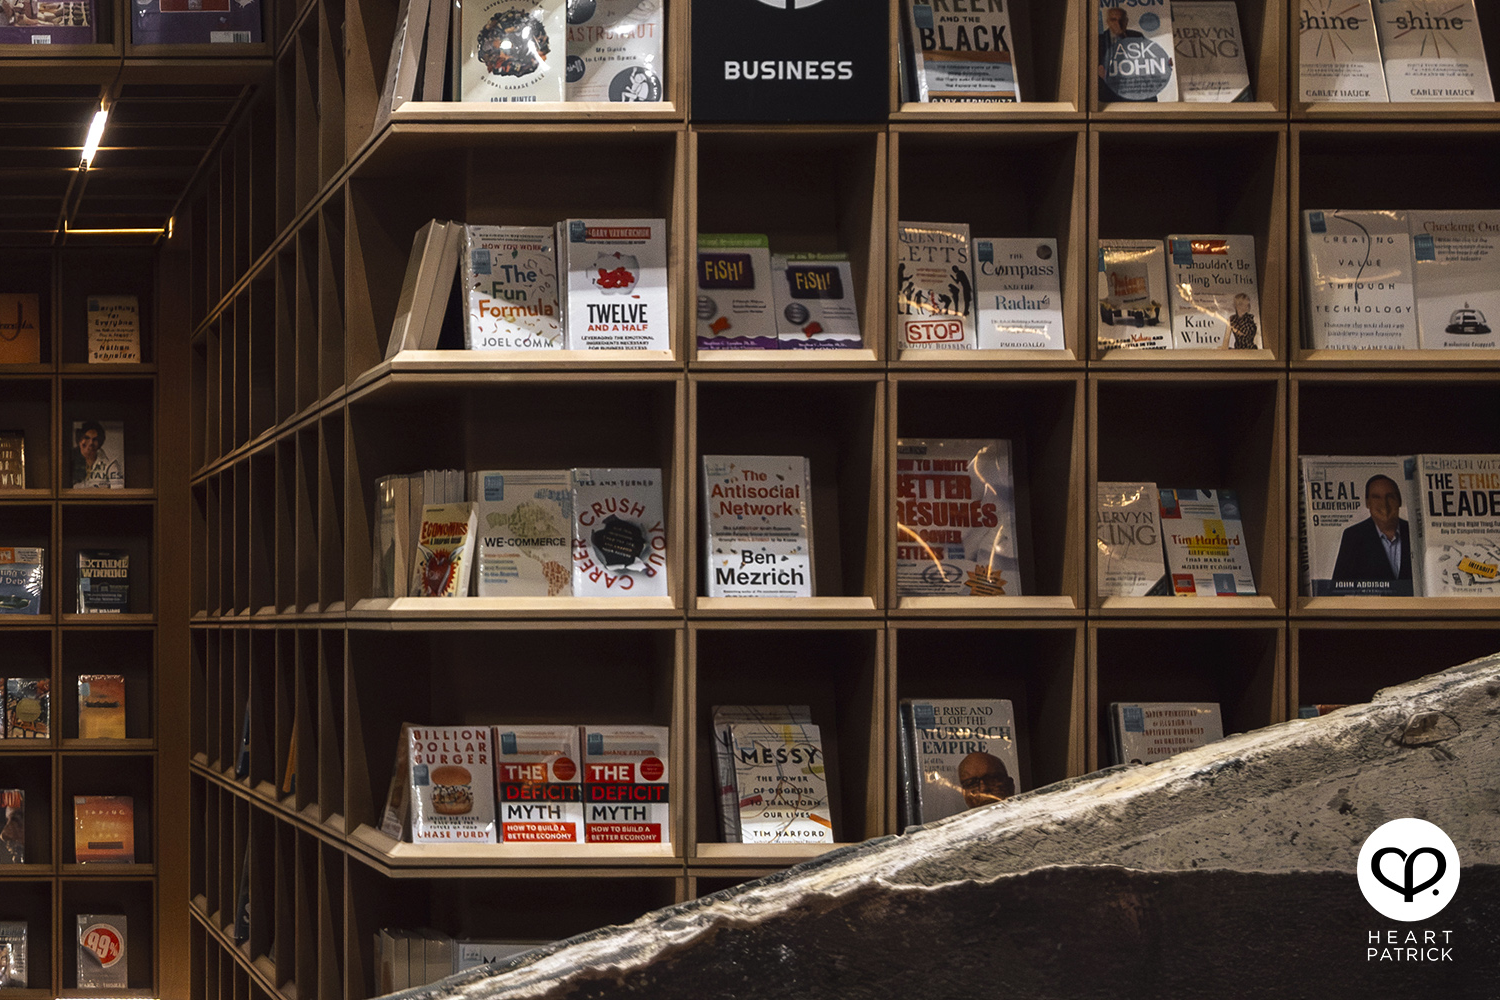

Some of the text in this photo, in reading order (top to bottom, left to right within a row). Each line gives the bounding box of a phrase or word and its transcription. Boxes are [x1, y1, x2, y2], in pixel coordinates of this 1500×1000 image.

[919, 25, 1011, 51] BLACK
[1114, 42, 1158, 60] ASK
[724, 61, 853, 80] BUSINESS
[1109, 58, 1166, 76] JOHN
[501, 264, 538, 283] The
[705, 260, 744, 281] FISH!
[981, 260, 1054, 279] Compass
[795, 271, 831, 290] FISH!
[1212, 274, 1253, 285] You This
[492, 281, 527, 301] Fun
[478, 299, 554, 318] Formula
[995, 295, 1043, 311] Radar
[1316, 305, 1412, 314] TECHNOLOGY
[587, 304, 648, 323] TWELVE
[588, 324, 647, 332] AND A HALF
[1185, 316, 1214, 329] Kate
[908, 322, 961, 340] STOP
[1181, 331, 1221, 345] White
[482, 337, 553, 348] JOEL COMM
[742, 470, 767, 482] The
[711, 484, 800, 499] Antisocial
[1311, 481, 1360, 500] REAL
[719, 501, 793, 517] Network
[1312, 501, 1361, 511] LEADERSHIP
[484, 537, 566, 548] WE-COMMERCE
[1171, 534, 1240, 547] Tim Harford
[81, 559, 129, 568] EXTREME
[741, 549, 776, 565] Ben
[82, 568, 127, 578] WINNING
[715, 566, 804, 586] Mezrich
[943, 706, 993, 716] RISE AND
[414, 730, 486, 741] BILLION
[921, 726, 1012, 741] MURDOCH
[414, 742, 487, 753] DOLLAR
[923, 741, 989, 755] EMPIRE
[415, 754, 488, 765] BURGER
[740, 748, 820, 764] MESSY
[505, 765, 543, 780] THE
[591, 766, 629, 780] THE
[506, 785, 577, 800] DEFICIT
[592, 786, 665, 801] DEFICIT
[508, 805, 561, 820] MYTH
[592, 805, 646, 820] MYTH
[417, 831, 490, 839] CHASE PURDY
[537, 833, 572, 841] ECONOMY
[775, 830, 825, 838] HARFORD
